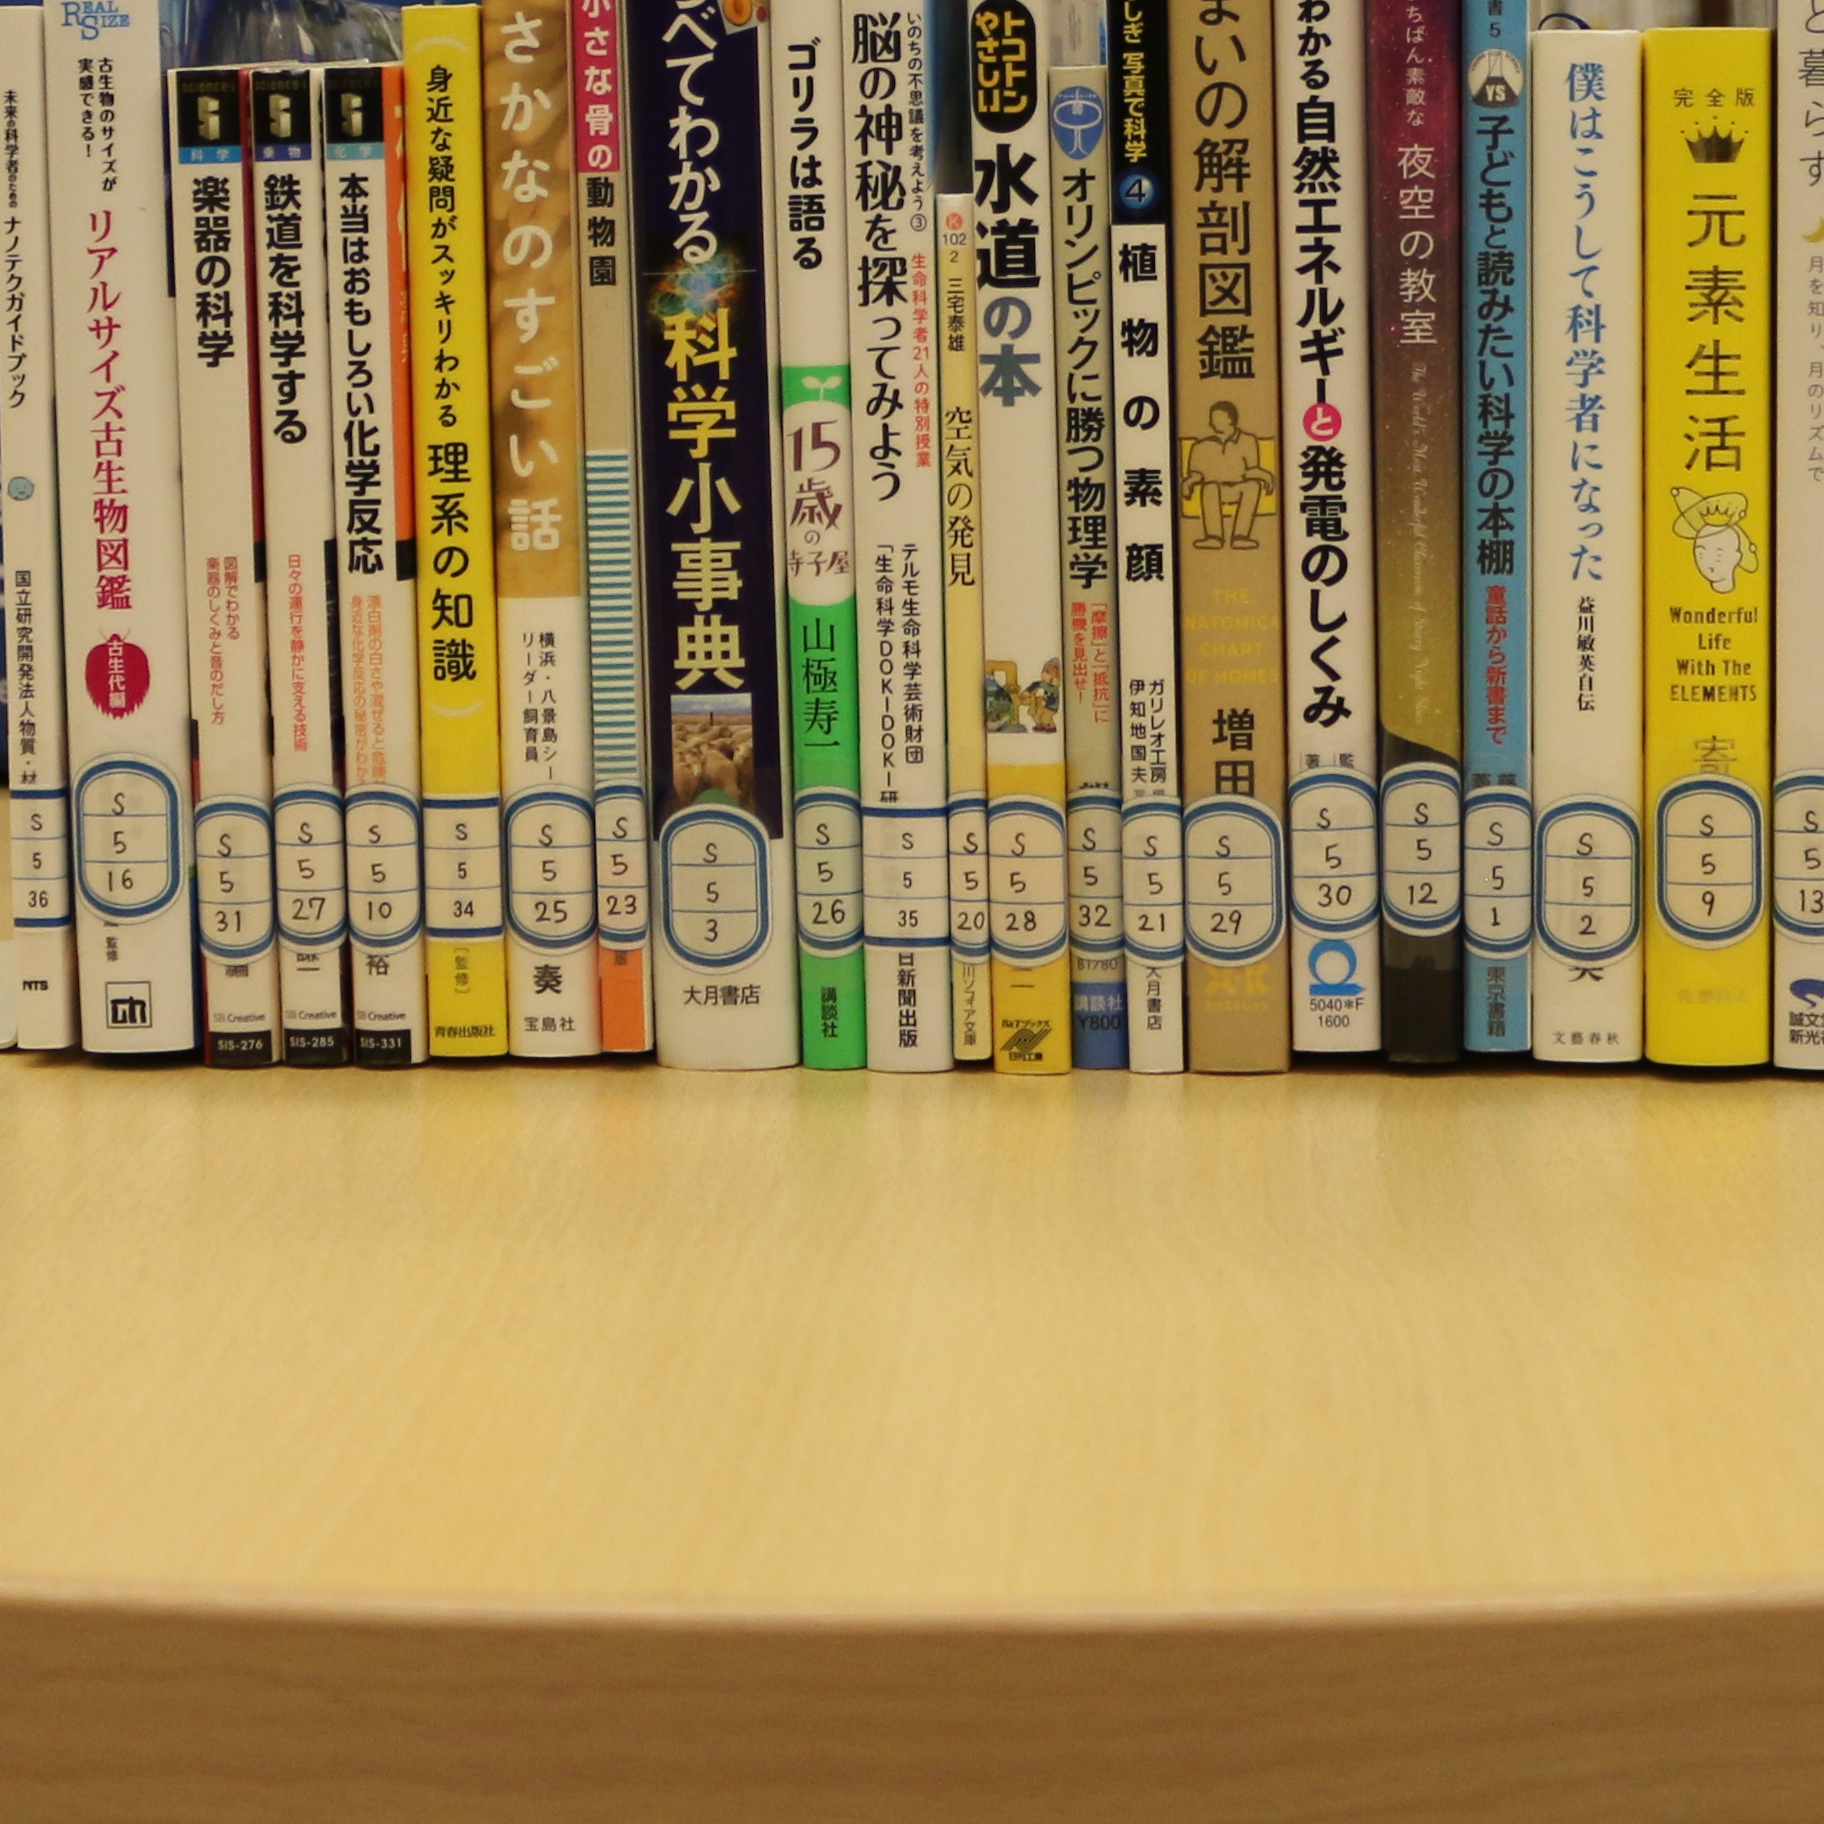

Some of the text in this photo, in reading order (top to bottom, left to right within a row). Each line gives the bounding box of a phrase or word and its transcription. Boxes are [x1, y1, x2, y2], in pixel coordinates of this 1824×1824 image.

[61, 0, 119, 28] REAL
[81, 13, 130, 41] SIZE
[976, 11, 1000, 114] やさしい
[1003, 11, 1028, 114] トコトン
[1489, 23, 1502, 38] 5
[97, 57, 118, 194] 古生物のサイズが
[1123, 52, 1147, 162] 写真で科学
[1486, 84, 1506, 102] YS
[1674, 88, 1754, 109] 完全版
[788, 38, 827, 270] ゴリラは語る
[1124, 180, 1148, 202] 4
[3, 90, 27, 409] 未来の科学者のための ナノテクガイドブック
[191, 175, 235, 369] 楽器の科学
[425, 65, 458, 429] 身近な疑問がスッキリわかる
[499, 11, 562, 553] さかなのすごい話
[853, 12, 908, 502] 脳の神秘を探ってみよう
[974, 144, 1042, 408] 水道の本
[1397, 144, 1438, 346] 夜空の教室
[262, 174, 308, 444] 鉄道を科学する
[911, 252, 932, 468] 生命科学者21人の特別授業
[1476, 116, 1515, 575] 子どもと読みたい科学の本棚
[1564, 62, 1607, 581] 僕はこうして科学者になった
[1684, 193, 1747, 473] 元素生活
[87, 210, 132, 610] リアルサイズ古生物図鑑
[338, 174, 385, 575] 本当はおもしろい化学反応
[1061, 168, 1109, 590] オリンピックに勝つ物理学
[1118, 244, 1165, 583] 植物の素顔
[663, 307, 746, 691] 科学小事典
[944, 406, 976, 588] 空気の発見
[427, 442, 476, 682] 理系の知識
[205, 557, 225, 724] 楽器のしくみと音のだし方
[287, 554, 308, 752] 日々の運行を静かに支える技術
[1669, 607, 1758, 624] Wonderful
[1697, 634, 1732, 651] Life
[106, 640, 127, 708] 古生代編
[802, 618, 840, 749] 山極寿一
[1670, 685, 1757, 702] ELEMENTS
[1676, 659, 1752, 676] With The
[298, 823, 313, 844] S
[298, 858, 315, 878] 5
[816, 824, 830, 846] S
[816, 862, 834, 882] 5
[1144, 836, 1158, 857] S
[1148, 873, 1163, 895] 5
[1487, 822, 1505, 846] S
[1491, 865, 1505, 890] 5
[292, 897, 326, 920] 27
[812, 900, 846, 924] 26
[1138, 913, 1166, 932] 21
[1490, 907, 1502, 926] 1
[23, 979, 48, 991] NTS
[1317, 1015, 1350, 1027] 1600
[217, 1039, 263, 1050] SIS-276
